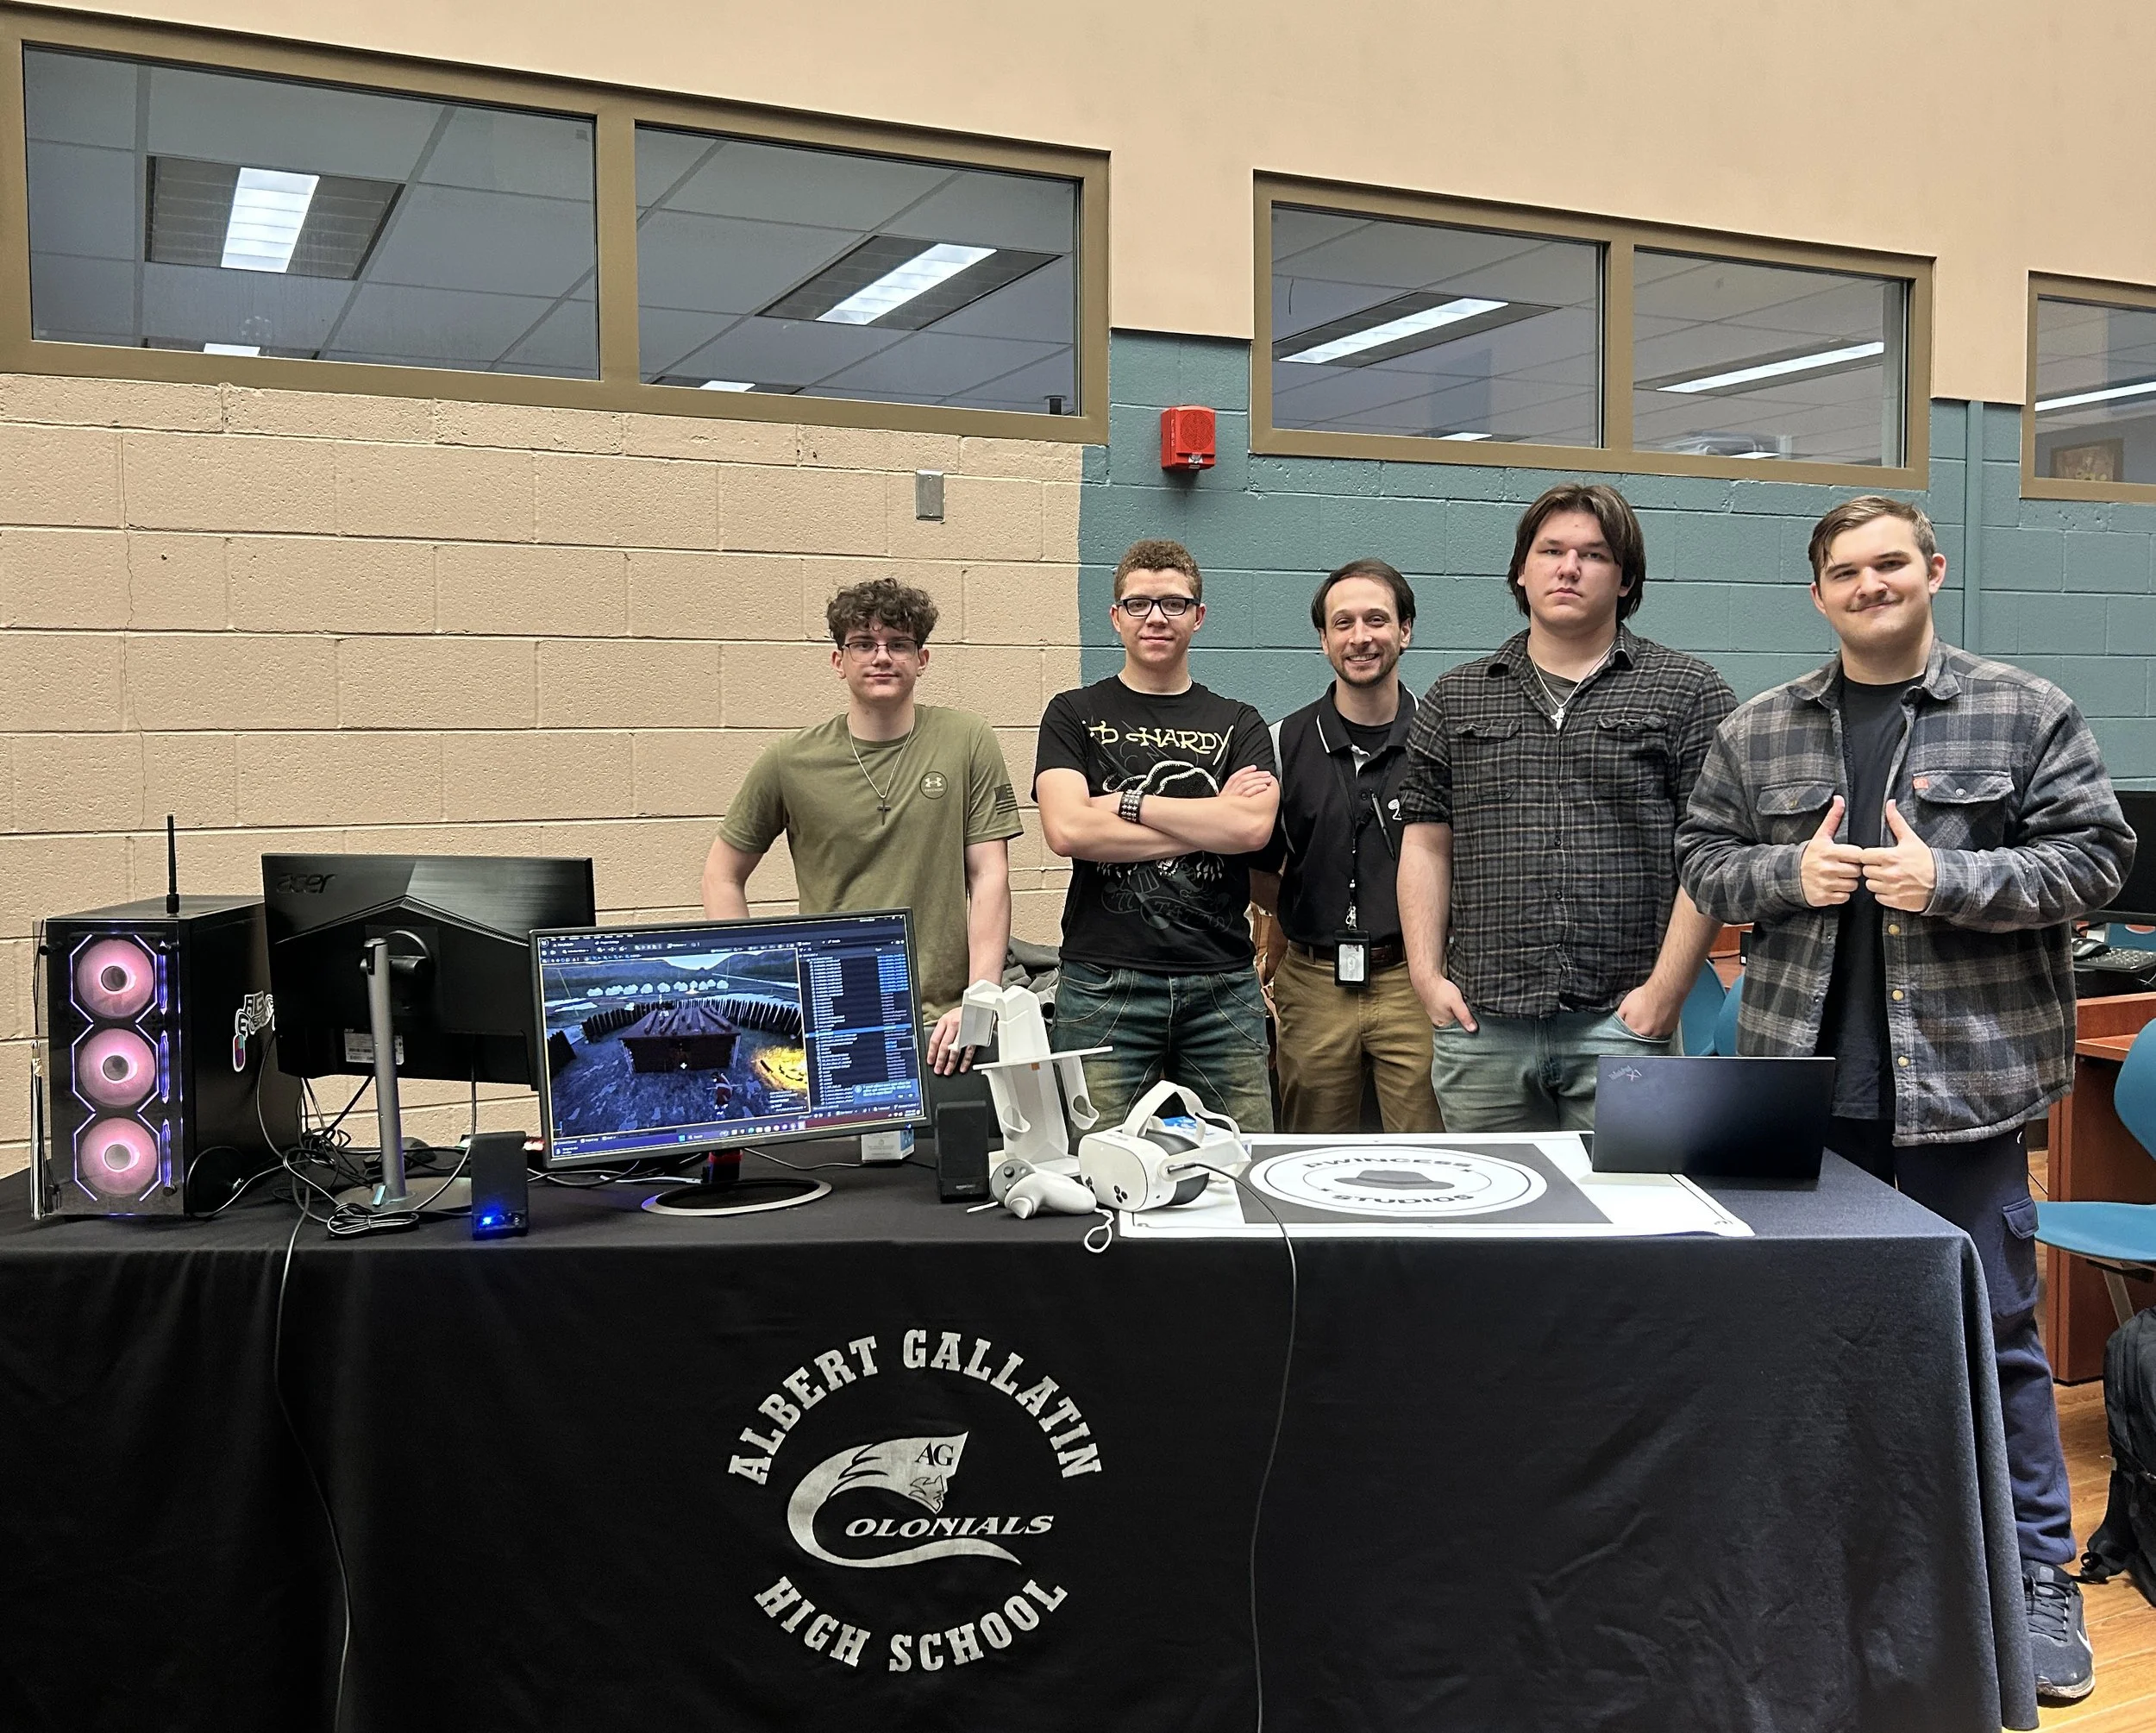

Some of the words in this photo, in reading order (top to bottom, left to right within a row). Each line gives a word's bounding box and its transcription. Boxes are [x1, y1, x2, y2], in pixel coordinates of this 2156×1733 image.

[1125, 725, 1235, 766] HARDY
[277, 872, 337, 894] acer
[1303, 1158, 1472, 1168] PWINCESS
[1332, 1194, 1474, 1204] STUDIOS
[728, 1336, 878, 1485] ALBERT
[903, 1329, 1101, 1479] GALLATIN
[914, 1441, 955, 1467] AG
[755, 1576, 871, 1667] HIGH
[888, 1579, 1069, 1672] SCHOOL
